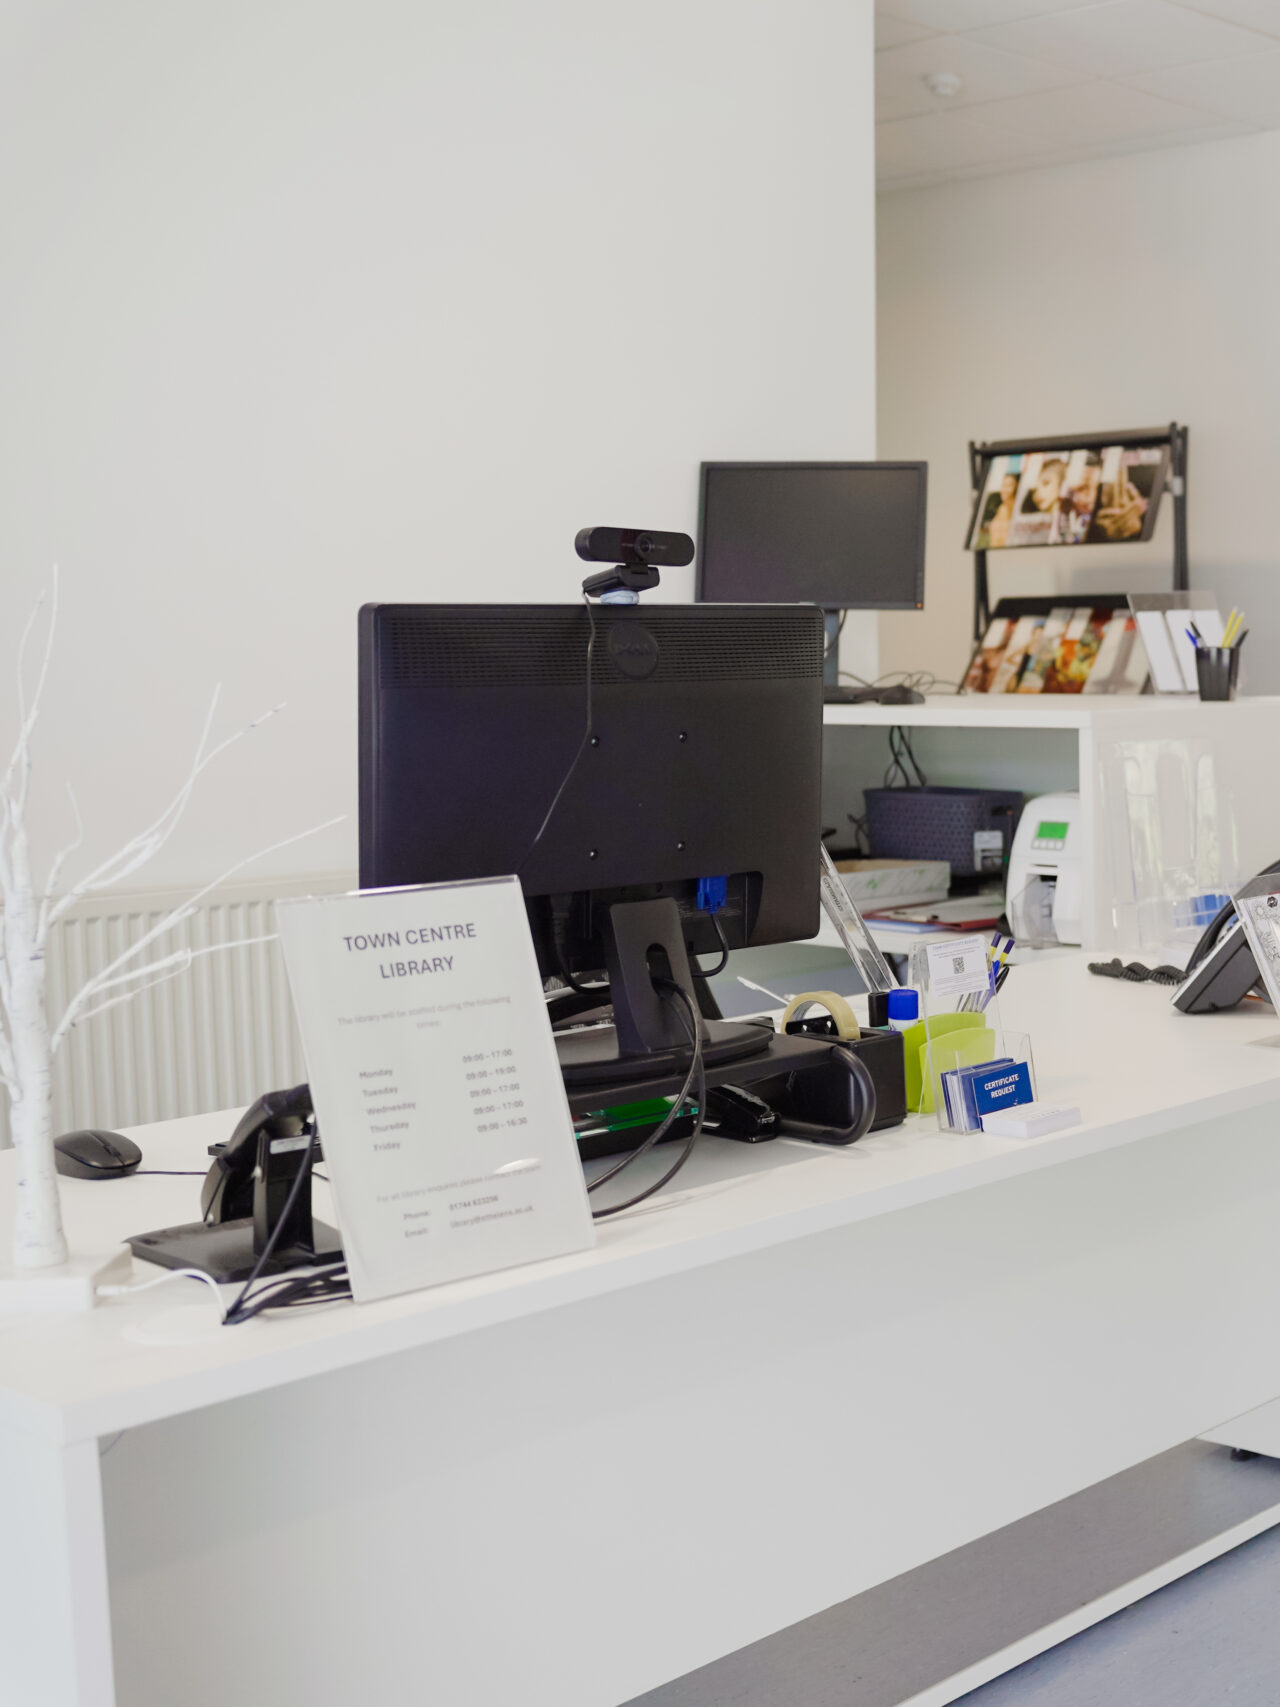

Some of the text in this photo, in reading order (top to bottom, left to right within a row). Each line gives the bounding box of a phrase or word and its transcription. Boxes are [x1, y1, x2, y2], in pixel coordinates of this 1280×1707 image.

[342, 922, 477, 952] TOWN CENTRE
[379, 955, 453, 979] LIBRARY
[359, 1069, 393, 1080] Monday
[984, 1073, 1020, 1091] CERTIFICATE
[362, 1087, 398, 1098] Tuesday
[990, 1084, 1016, 1099] REQUEST
[366, 1102, 416, 1115] Wednesday
[370, 1122, 409, 1133] Thursday
[373, 1142, 400, 1151] Friday
